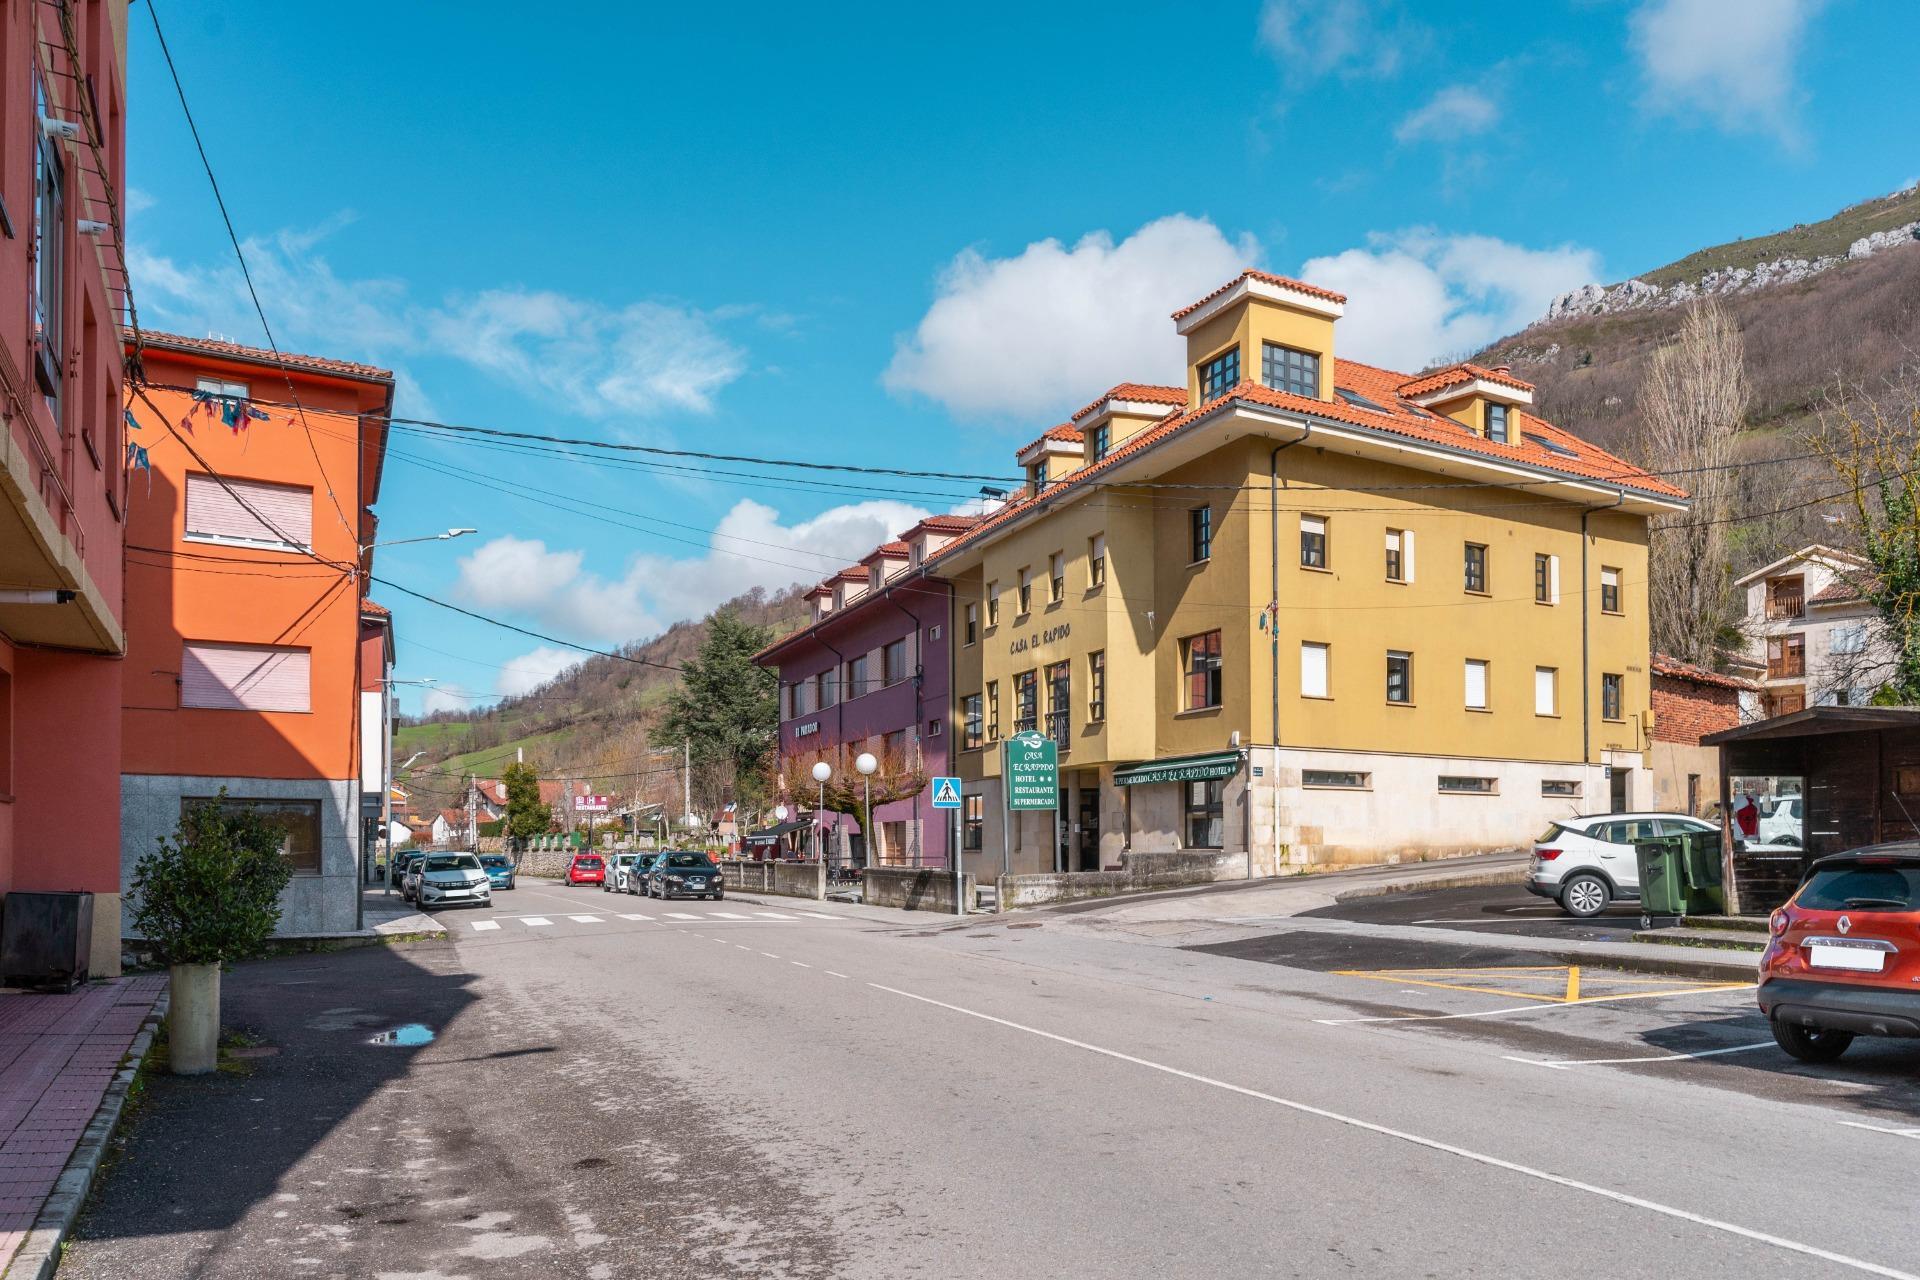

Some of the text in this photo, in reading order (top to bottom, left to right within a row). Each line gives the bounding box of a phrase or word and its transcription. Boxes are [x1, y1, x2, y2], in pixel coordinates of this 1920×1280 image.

[1010, 622, 1071, 655] CASA EL RAPIDO
[1024, 751, 1043, 761] CASA
[1012, 763, 1054, 772] EL RAPIDO
[1148, 771, 1167, 782] CASA
[1169, 770, 1178, 781] EL
[1179, 766, 1209, 780] RAPIDO
[1210, 766, 1227, 776] HOTEL
[1015, 775, 1037, 783] HOTEL
[1014, 786, 1054, 794] RESTAURANTE
[1014, 798, 1055, 806] SUPERMERCADO
